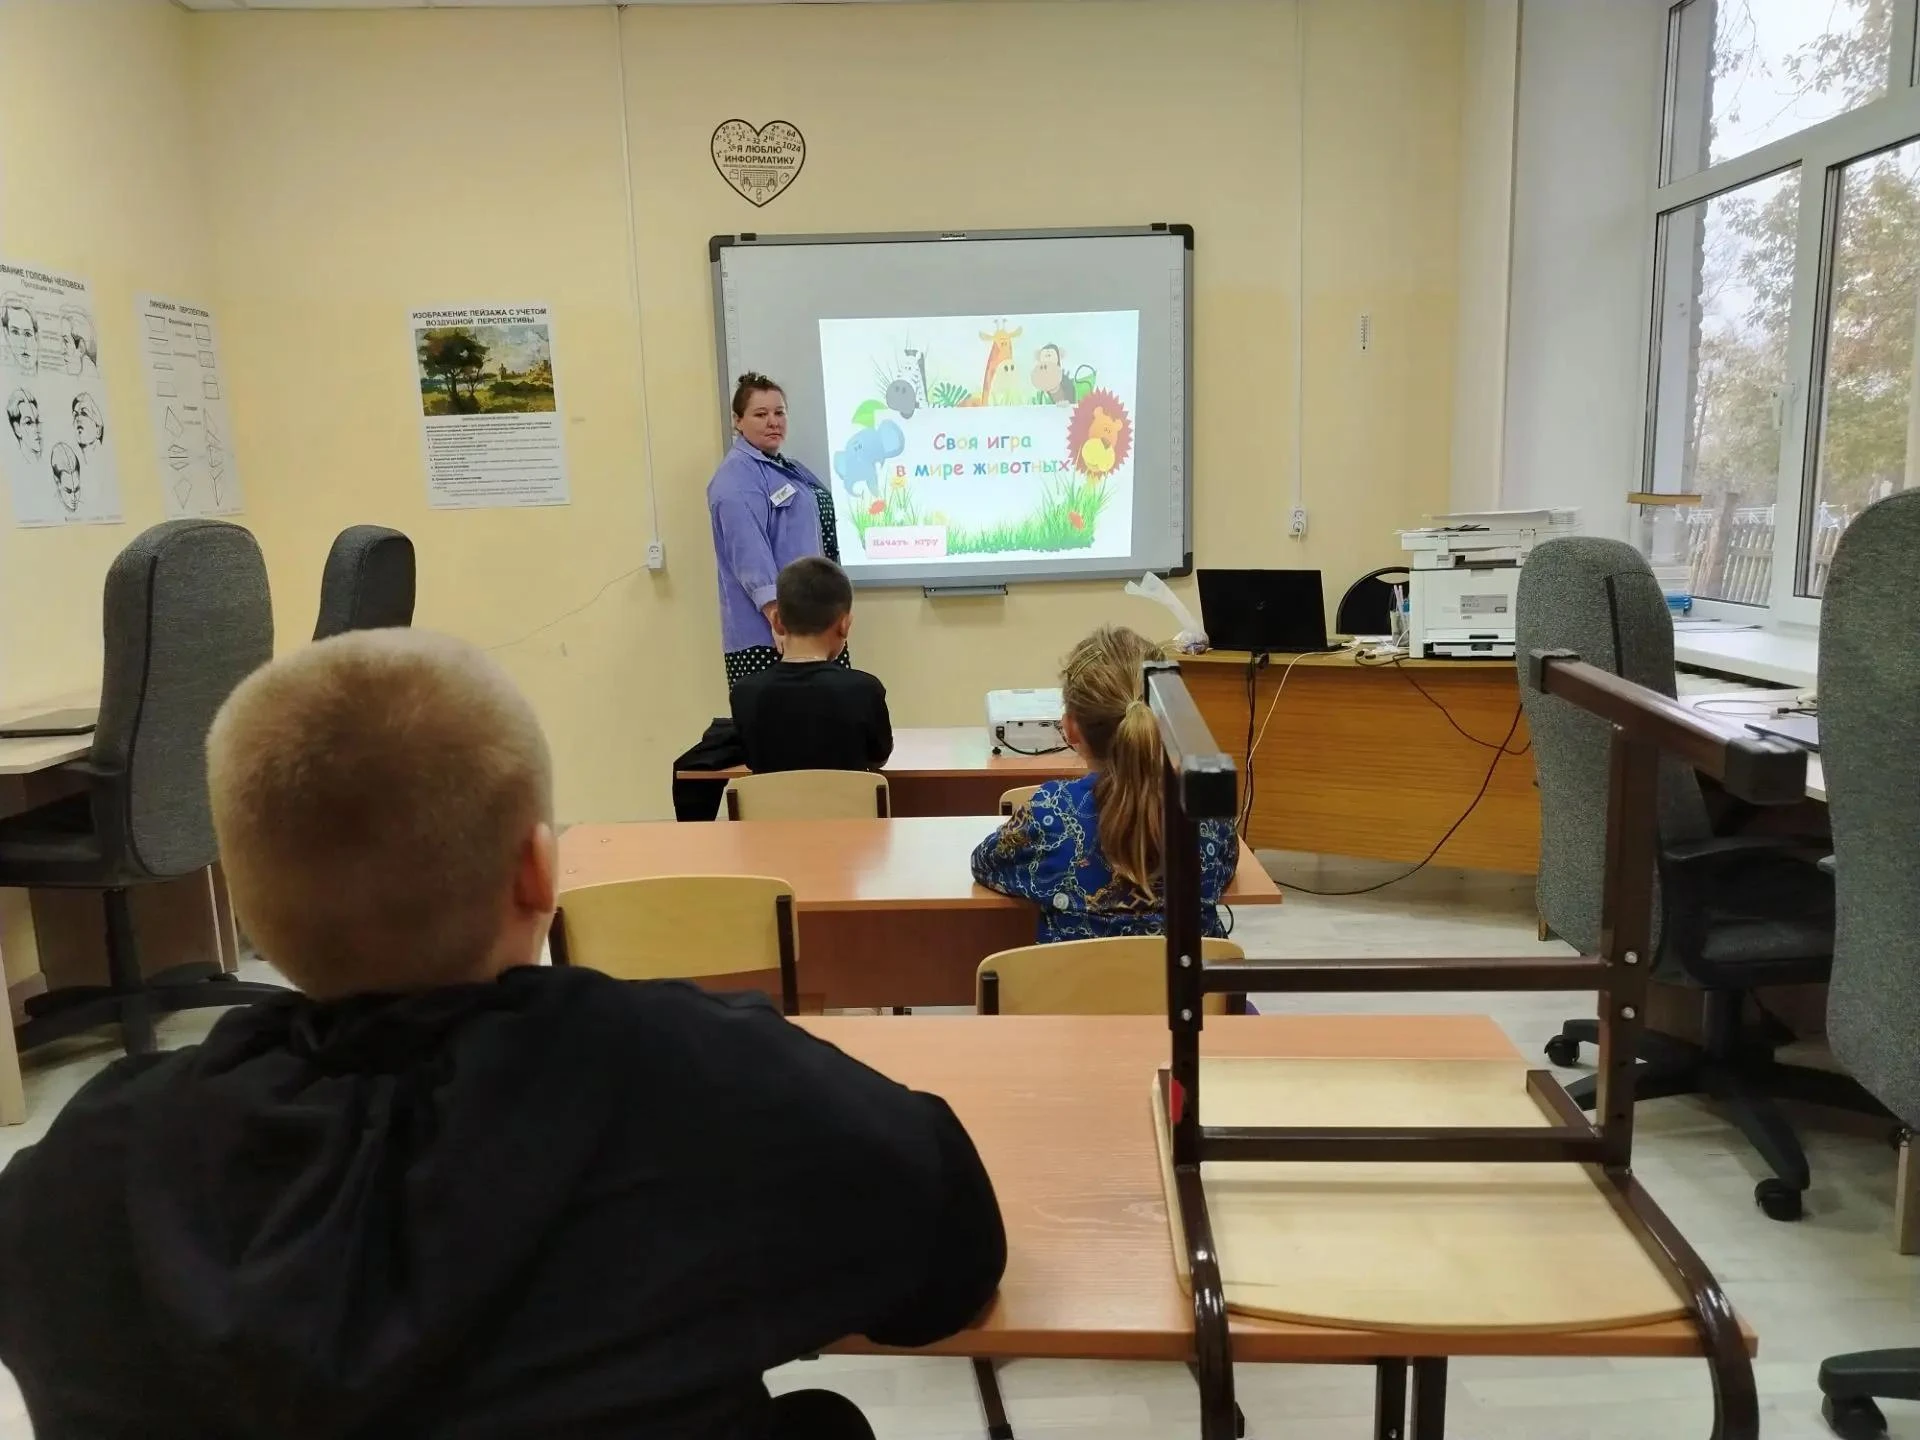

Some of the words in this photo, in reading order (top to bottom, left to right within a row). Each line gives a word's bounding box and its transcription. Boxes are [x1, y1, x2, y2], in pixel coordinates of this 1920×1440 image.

[737, 144, 743, 153] Я
[745, 144, 783, 154] ЛЮБЛЮ
[724, 155, 795, 164] ИНФОРМАТИКУ
[412, 310, 468, 319] ИЗОБРАЖЕНИЕ
[470, 308, 507, 317] ПЕЙЗАЖА
[508, 308, 514, 316] С
[515, 308, 547, 316] УЧЕТОМ
[425, 318, 474, 327] ВОЗДУШНОЙ
[477, 317, 535, 325] ПЕРСПЕКТИВЫ
[933, 432, 978, 450] Своя
[987, 435, 1032, 452] игра
[896, 465, 906, 477] в
[914, 462, 965, 480] мире
[973, 459, 1071, 476] животных
